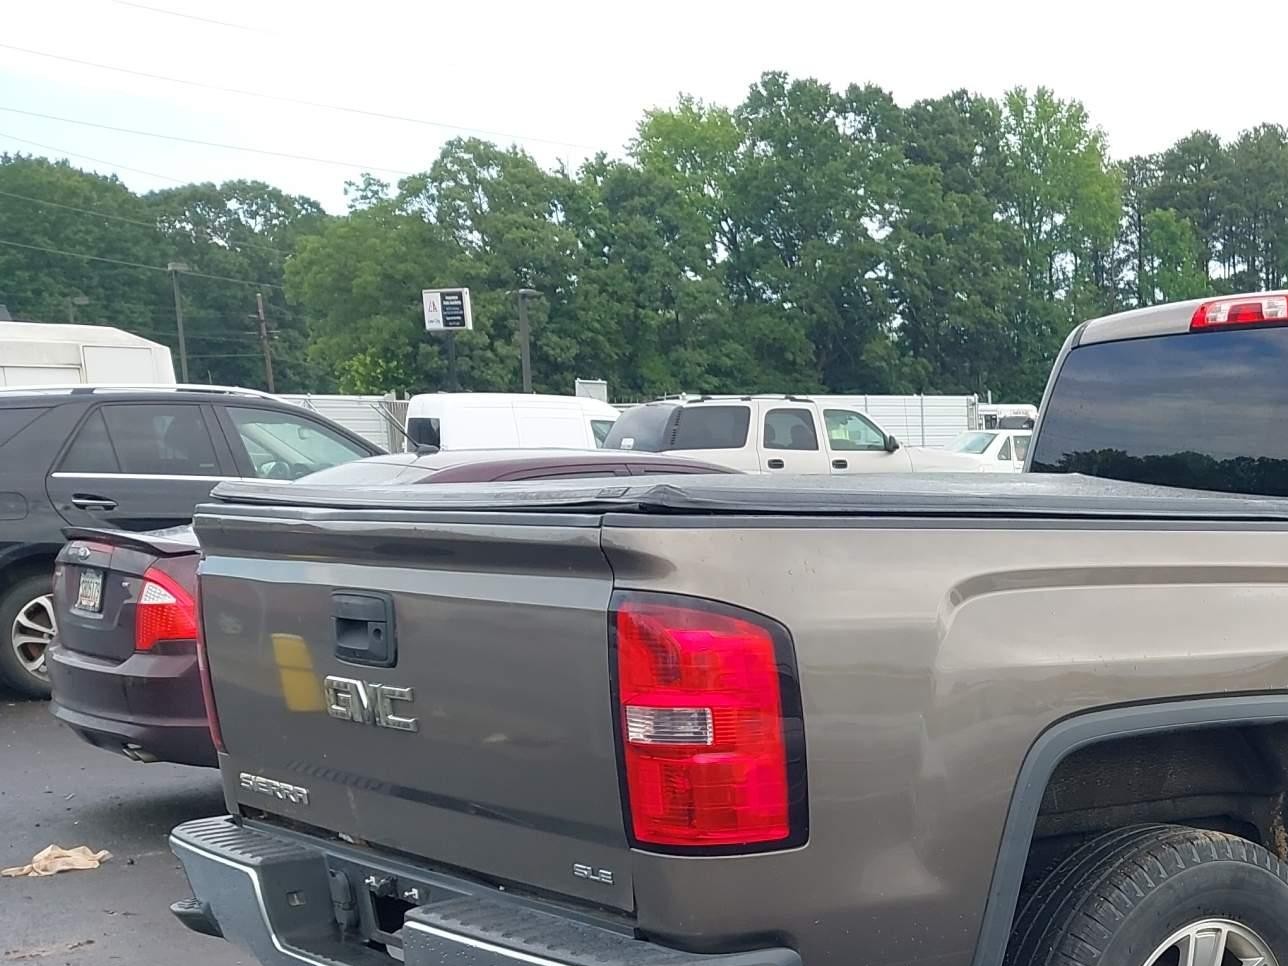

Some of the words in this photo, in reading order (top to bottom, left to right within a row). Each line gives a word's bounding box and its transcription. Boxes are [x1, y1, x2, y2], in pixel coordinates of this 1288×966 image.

[324, 675, 418, 733] GMC
[239, 772, 309, 805] SIERRA
[573, 863, 613, 885] SLE
